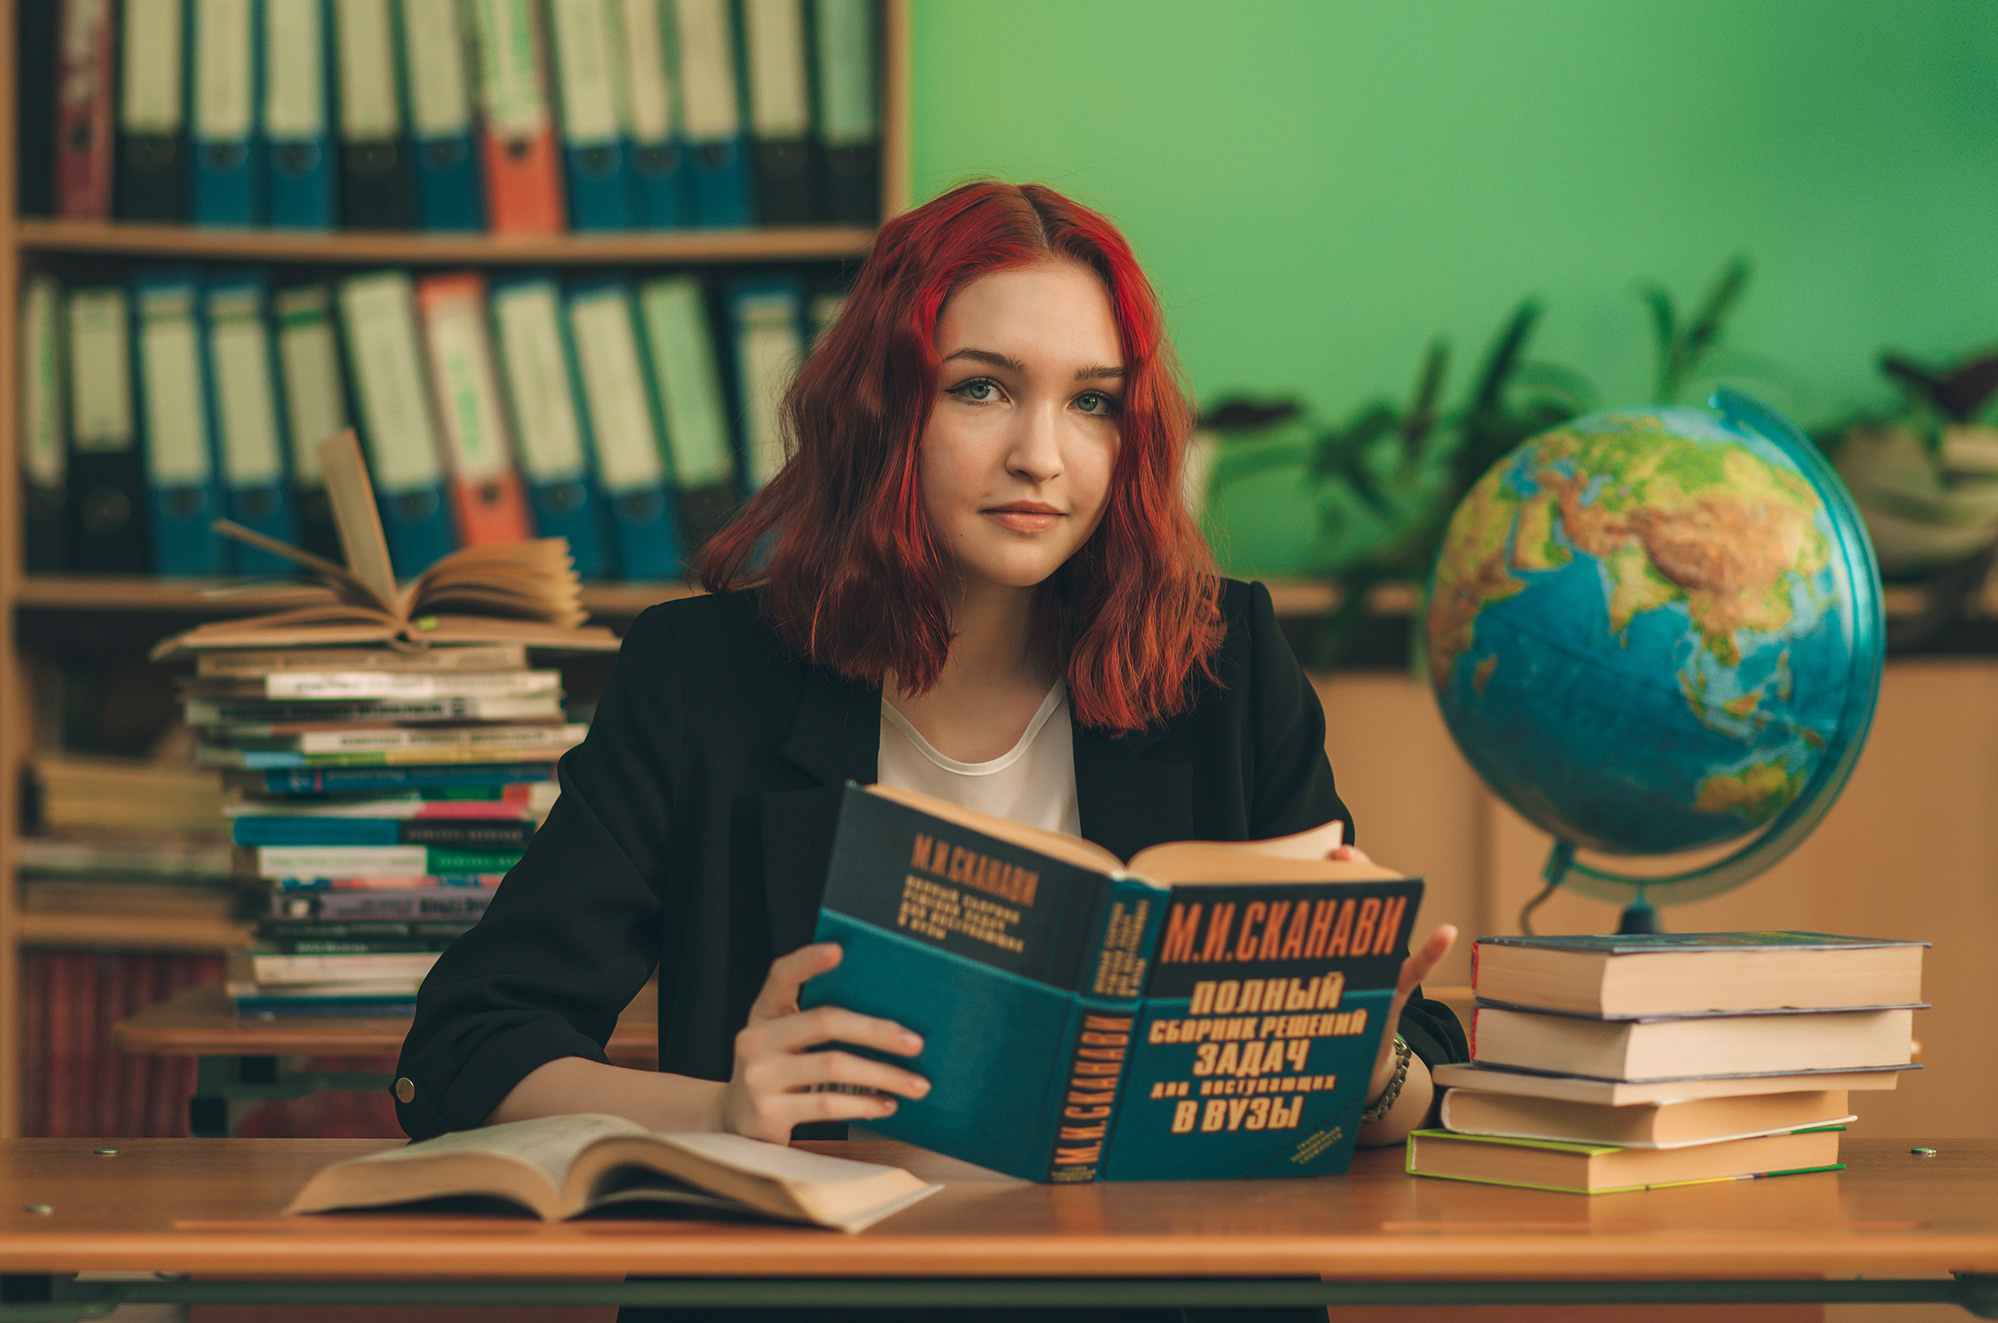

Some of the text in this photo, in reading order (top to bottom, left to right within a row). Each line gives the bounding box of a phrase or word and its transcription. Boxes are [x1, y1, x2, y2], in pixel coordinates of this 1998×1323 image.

[1161, 896, 1408, 963] М.И.СКАНАВИ
[1189, 971, 1345, 1015] ПОЛНЫЙ
[1148, 1009, 1368, 1044] СБОРНИК РЕШЕНИЙ
[1192, 1039, 1311, 1077] ЗАДАЧ
[1054, 1015, 1134, 1164] М.И.СКАНАВИ
[1171, 1096, 1304, 1133] В ВУЗЫ
